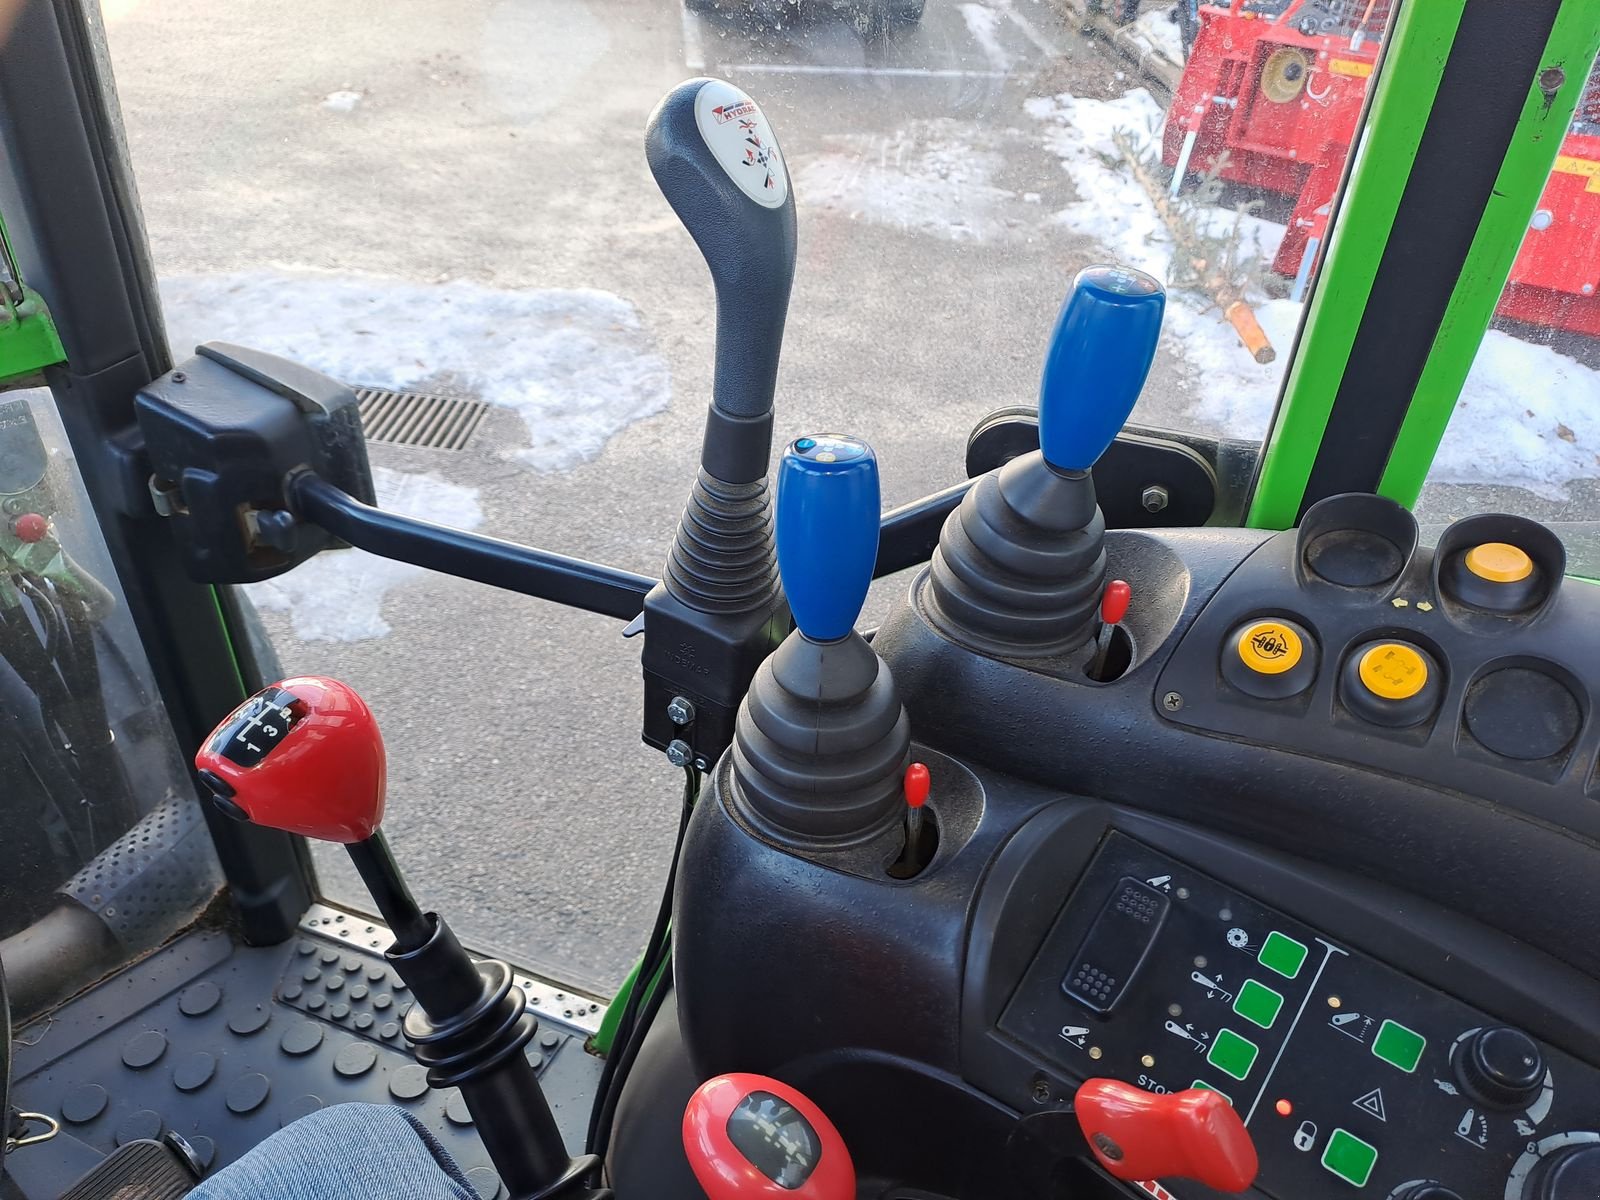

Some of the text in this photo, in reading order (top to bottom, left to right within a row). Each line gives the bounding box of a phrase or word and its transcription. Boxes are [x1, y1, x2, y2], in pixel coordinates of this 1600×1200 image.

[247, 742, 261, 752] 1
[263, 724, 278, 737] 3
[1138, 1074, 1174, 1095] STO
[1526, 1141, 1537, 1153] 6
